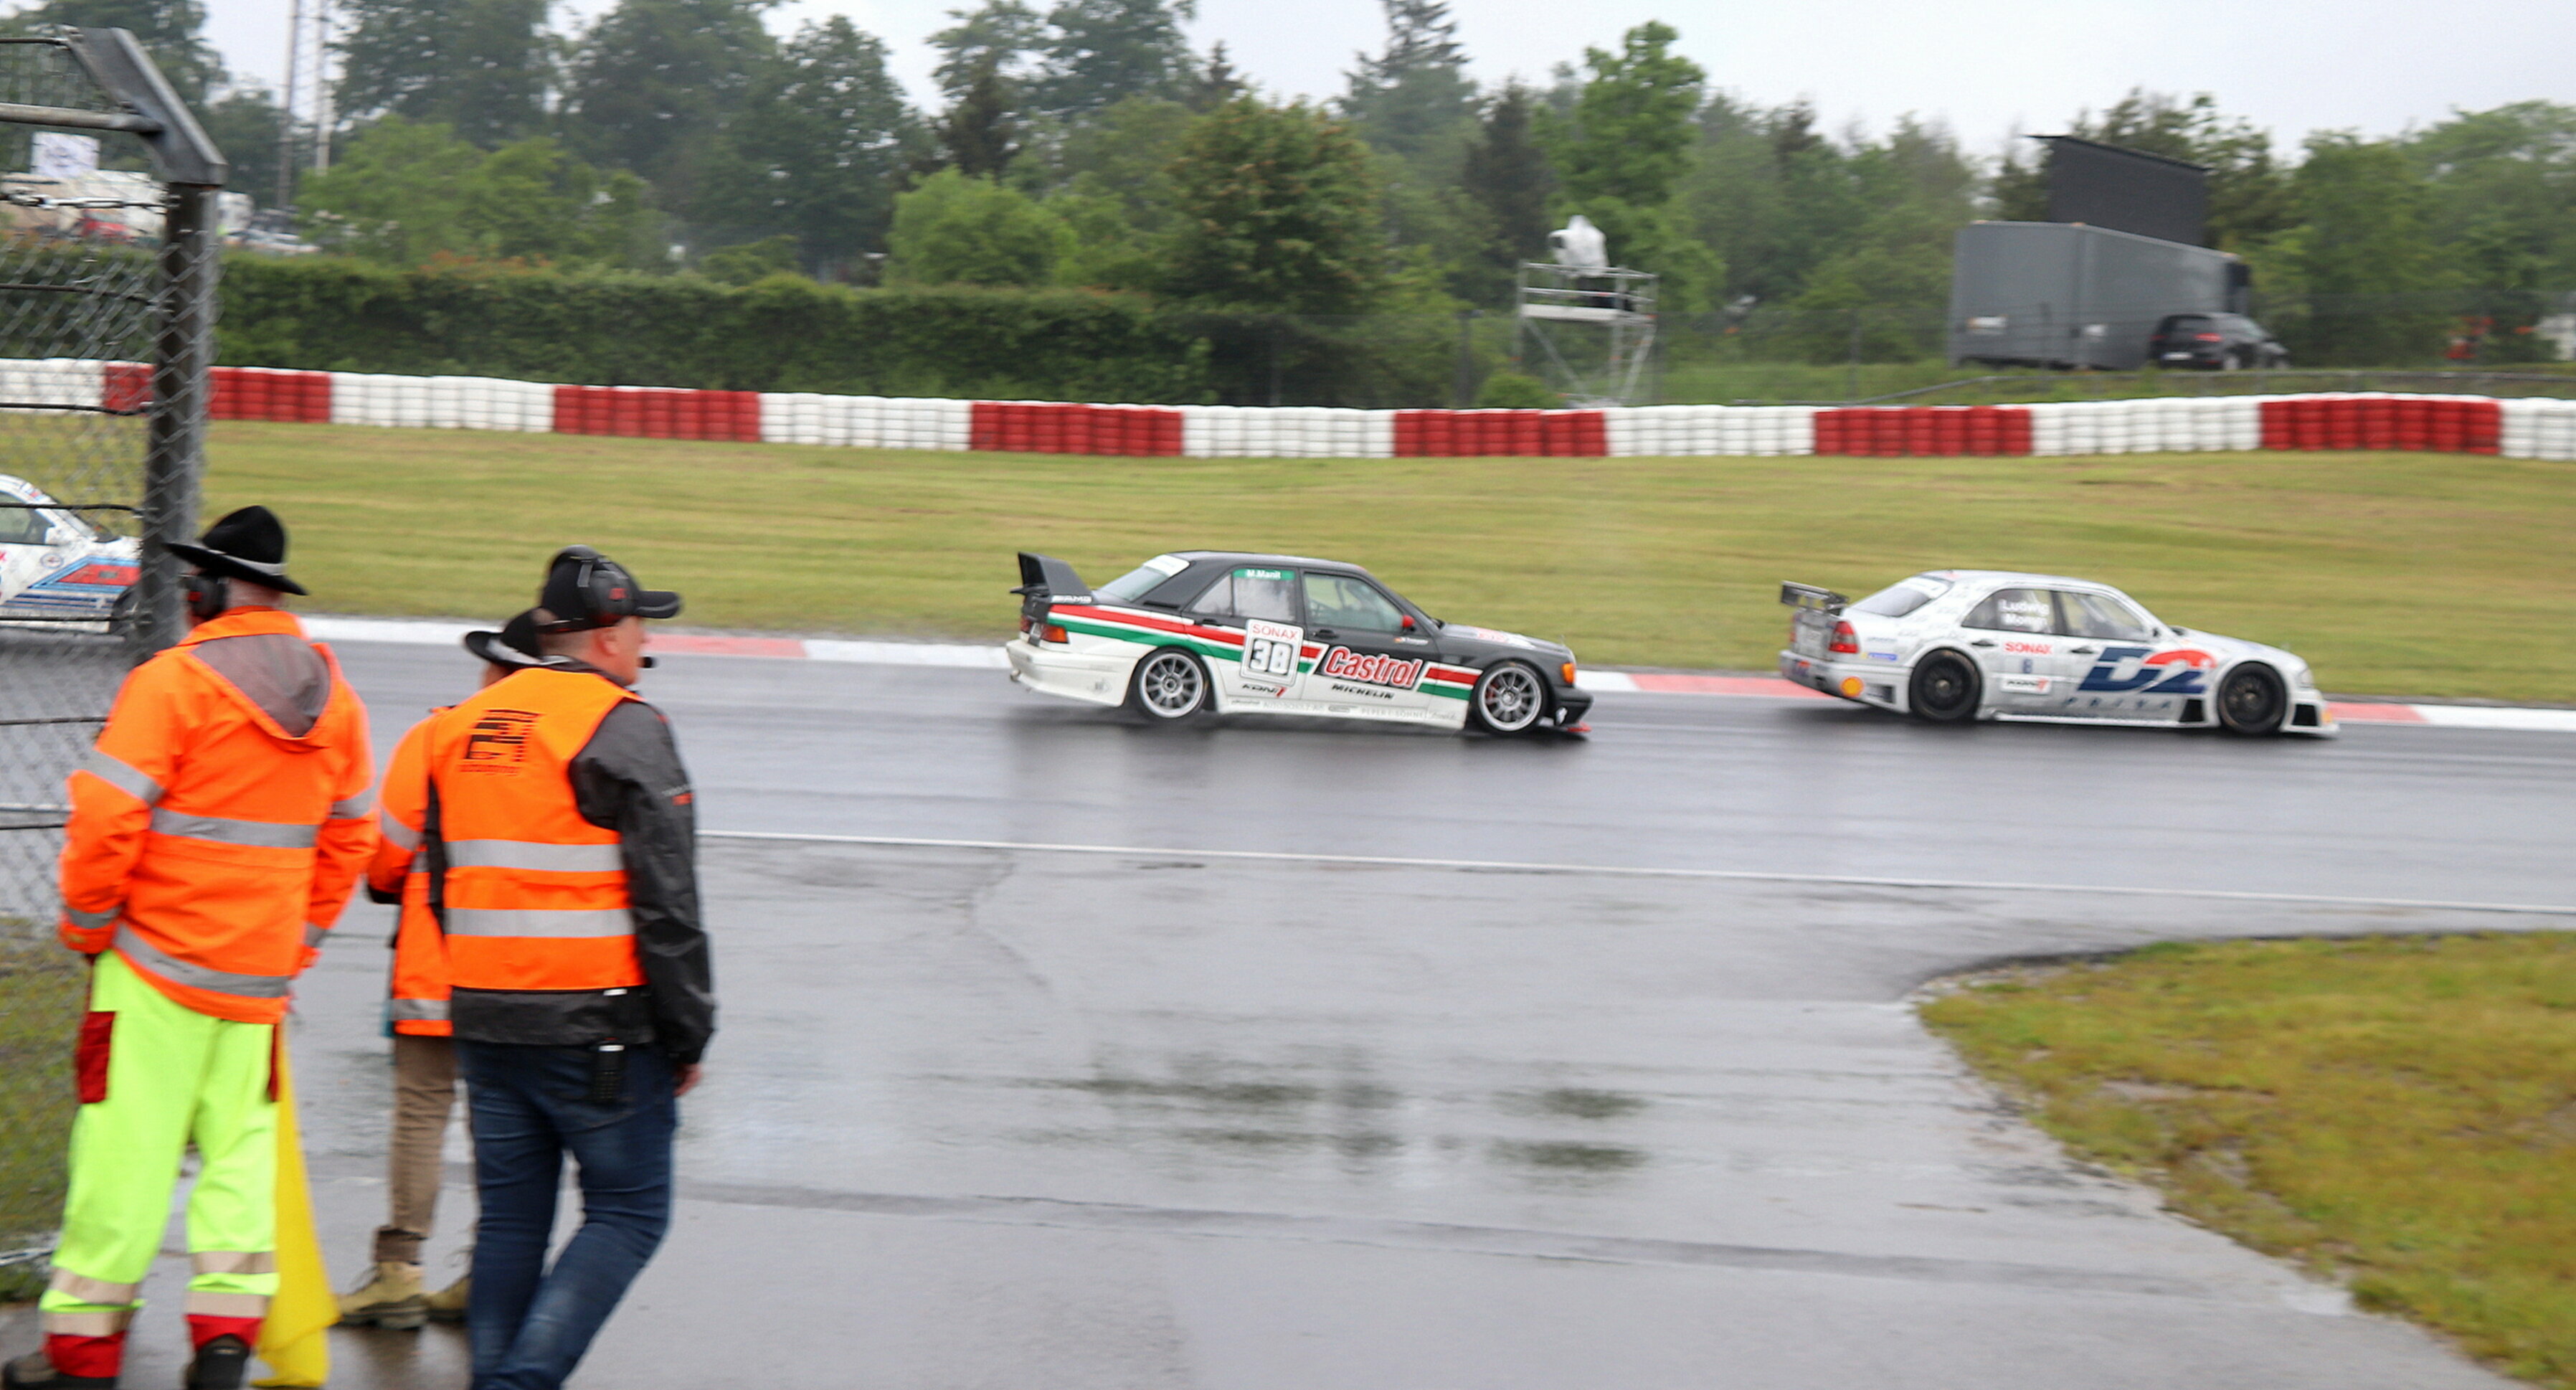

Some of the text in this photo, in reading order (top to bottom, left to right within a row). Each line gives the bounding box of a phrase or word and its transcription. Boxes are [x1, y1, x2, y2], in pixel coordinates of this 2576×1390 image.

[1252, 624, 1298, 641] SONAX
[1249, 638, 1292, 676] 38
[2004, 642, 2052, 655] SONAX
[1325, 646, 1423, 689] Castrol
[2078, 647, 2217, 694] D2
[1331, 684, 1395, 700] MICHELIN
